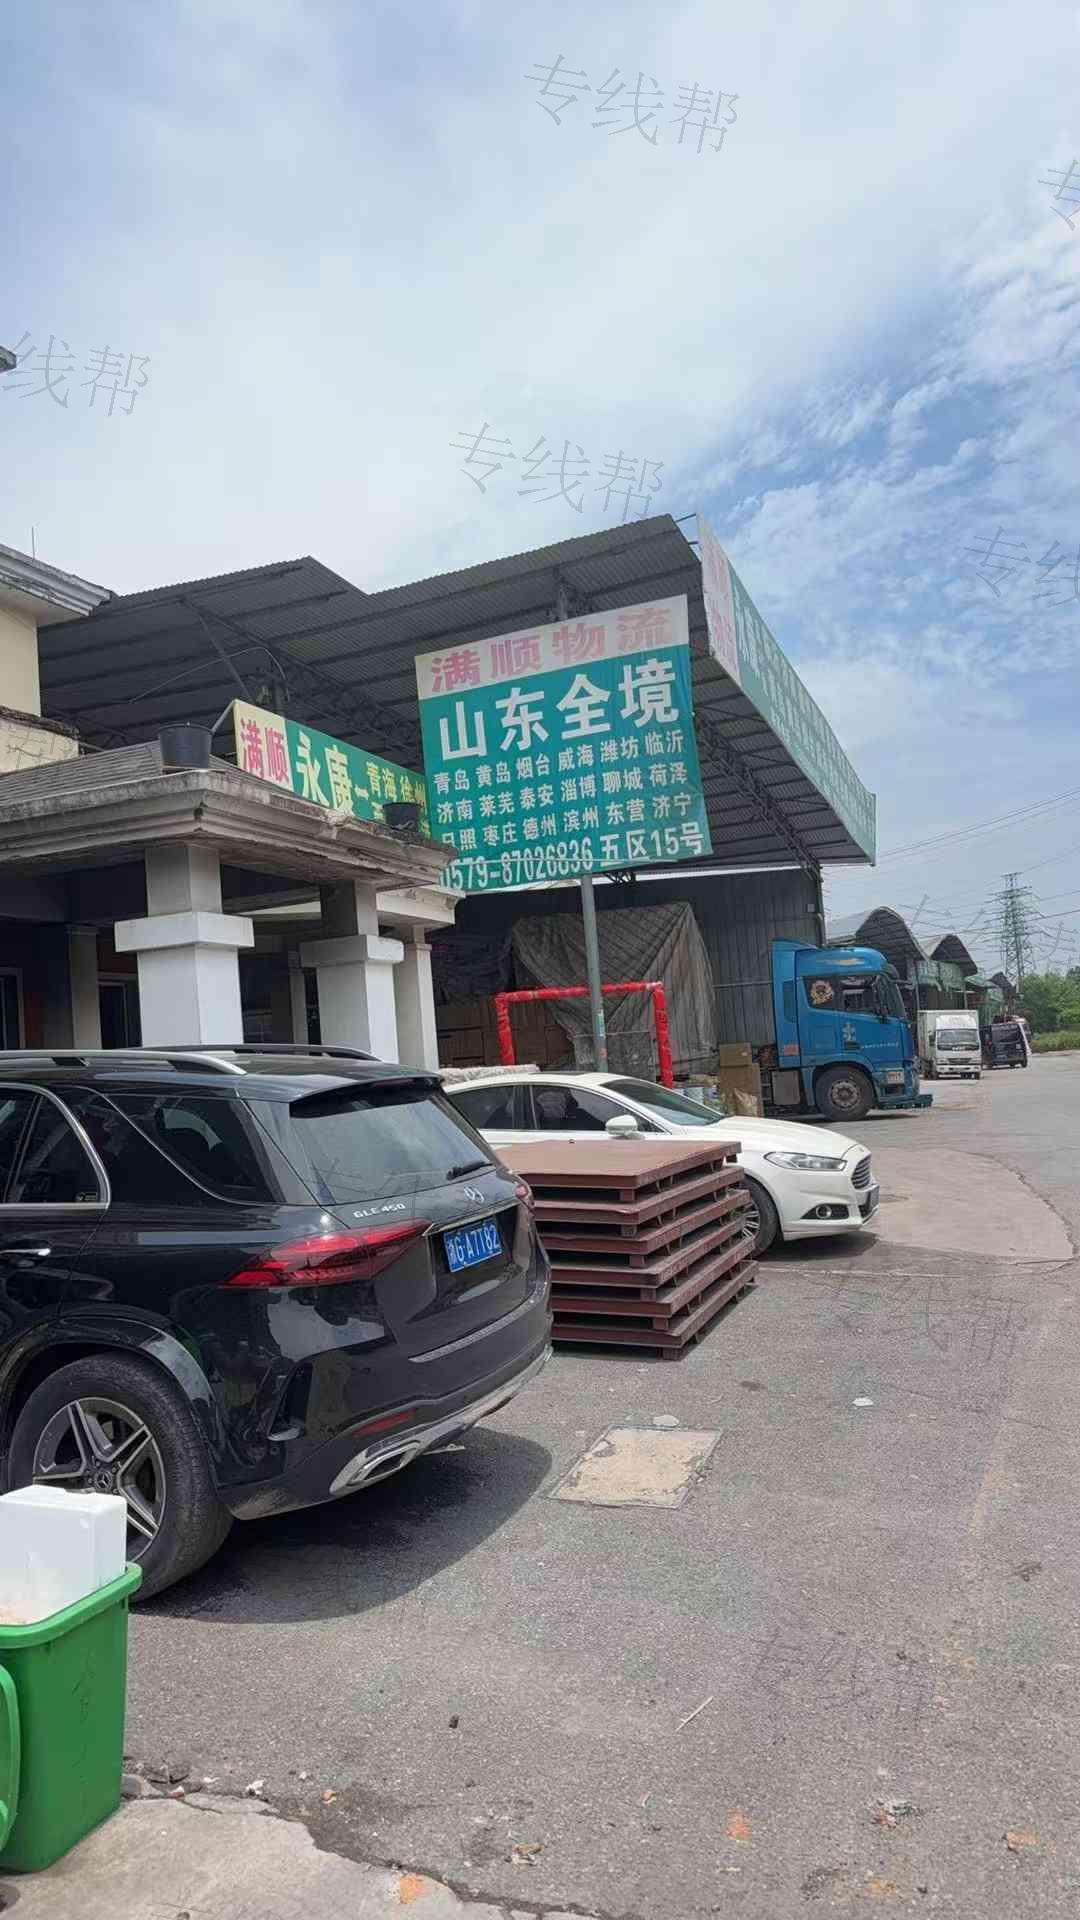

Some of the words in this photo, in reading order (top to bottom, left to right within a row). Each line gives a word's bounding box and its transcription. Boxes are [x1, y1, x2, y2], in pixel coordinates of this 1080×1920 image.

[431, 607, 673, 693] 满顺物流
[439, 659, 680, 761] 山东全境
[240, 717, 290, 785] 满顺
[433, 768, 471, 795] 青岛
[475, 761, 511, 788] 黄岛
[516, 753, 551, 780] 烟台
[558, 743, 595, 771] 威海
[600, 735, 640, 762] 潍坊
[644, 729, 684, 756] 临沂
[436, 798, 473, 825] 济南
[478, 791, 515, 818] 莱芜
[520, 783, 554, 810] 泰安
[560, 773, 597, 802] 淄博
[602, 766, 644, 794] 聊城
[482, 821, 518, 847] 枣庄
[522, 813, 557, 840] 德州
[563, 805, 600, 833] 滨州
[606, 798, 645, 825] 东营
[652, 792, 692, 818] 济宁
[599, 821, 704, 868] 五区15号
[353, 1207, 379, 1219] GLE
[381, 1202, 406, 1213] 450
